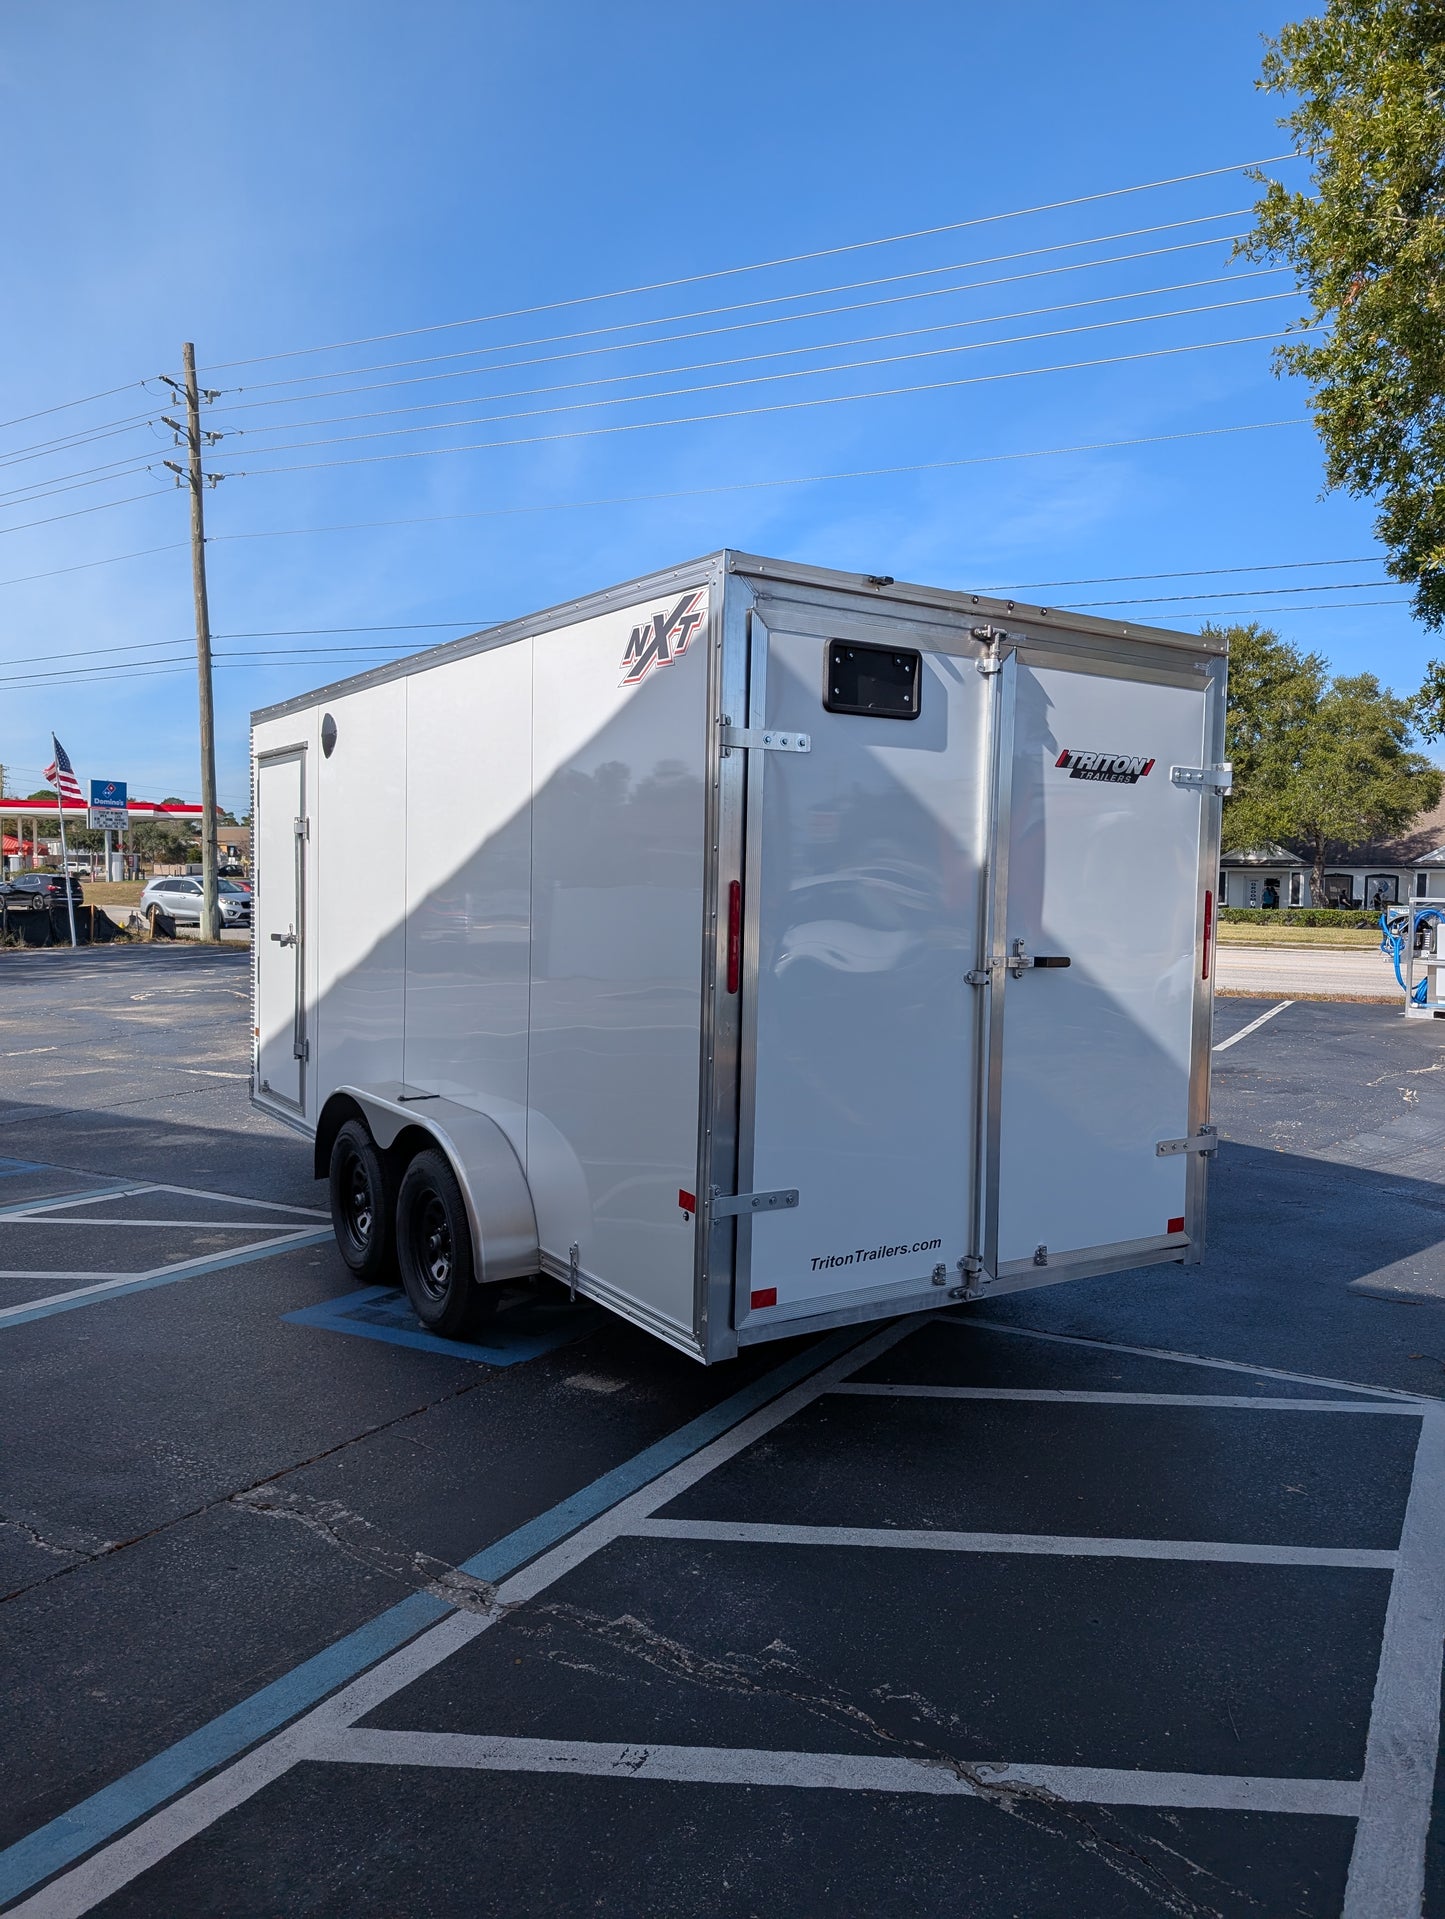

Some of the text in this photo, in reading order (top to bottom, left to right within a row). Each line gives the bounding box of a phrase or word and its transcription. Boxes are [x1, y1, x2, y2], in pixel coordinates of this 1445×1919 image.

[622, 590, 705, 684] NXT
[1066, 750, 1148, 775] TRITON
[1079, 770, 1132, 783] TRAILERS
[94, 798, 124, 806] Domino's
[810, 1238, 942, 1271] TritonTrailers.com
